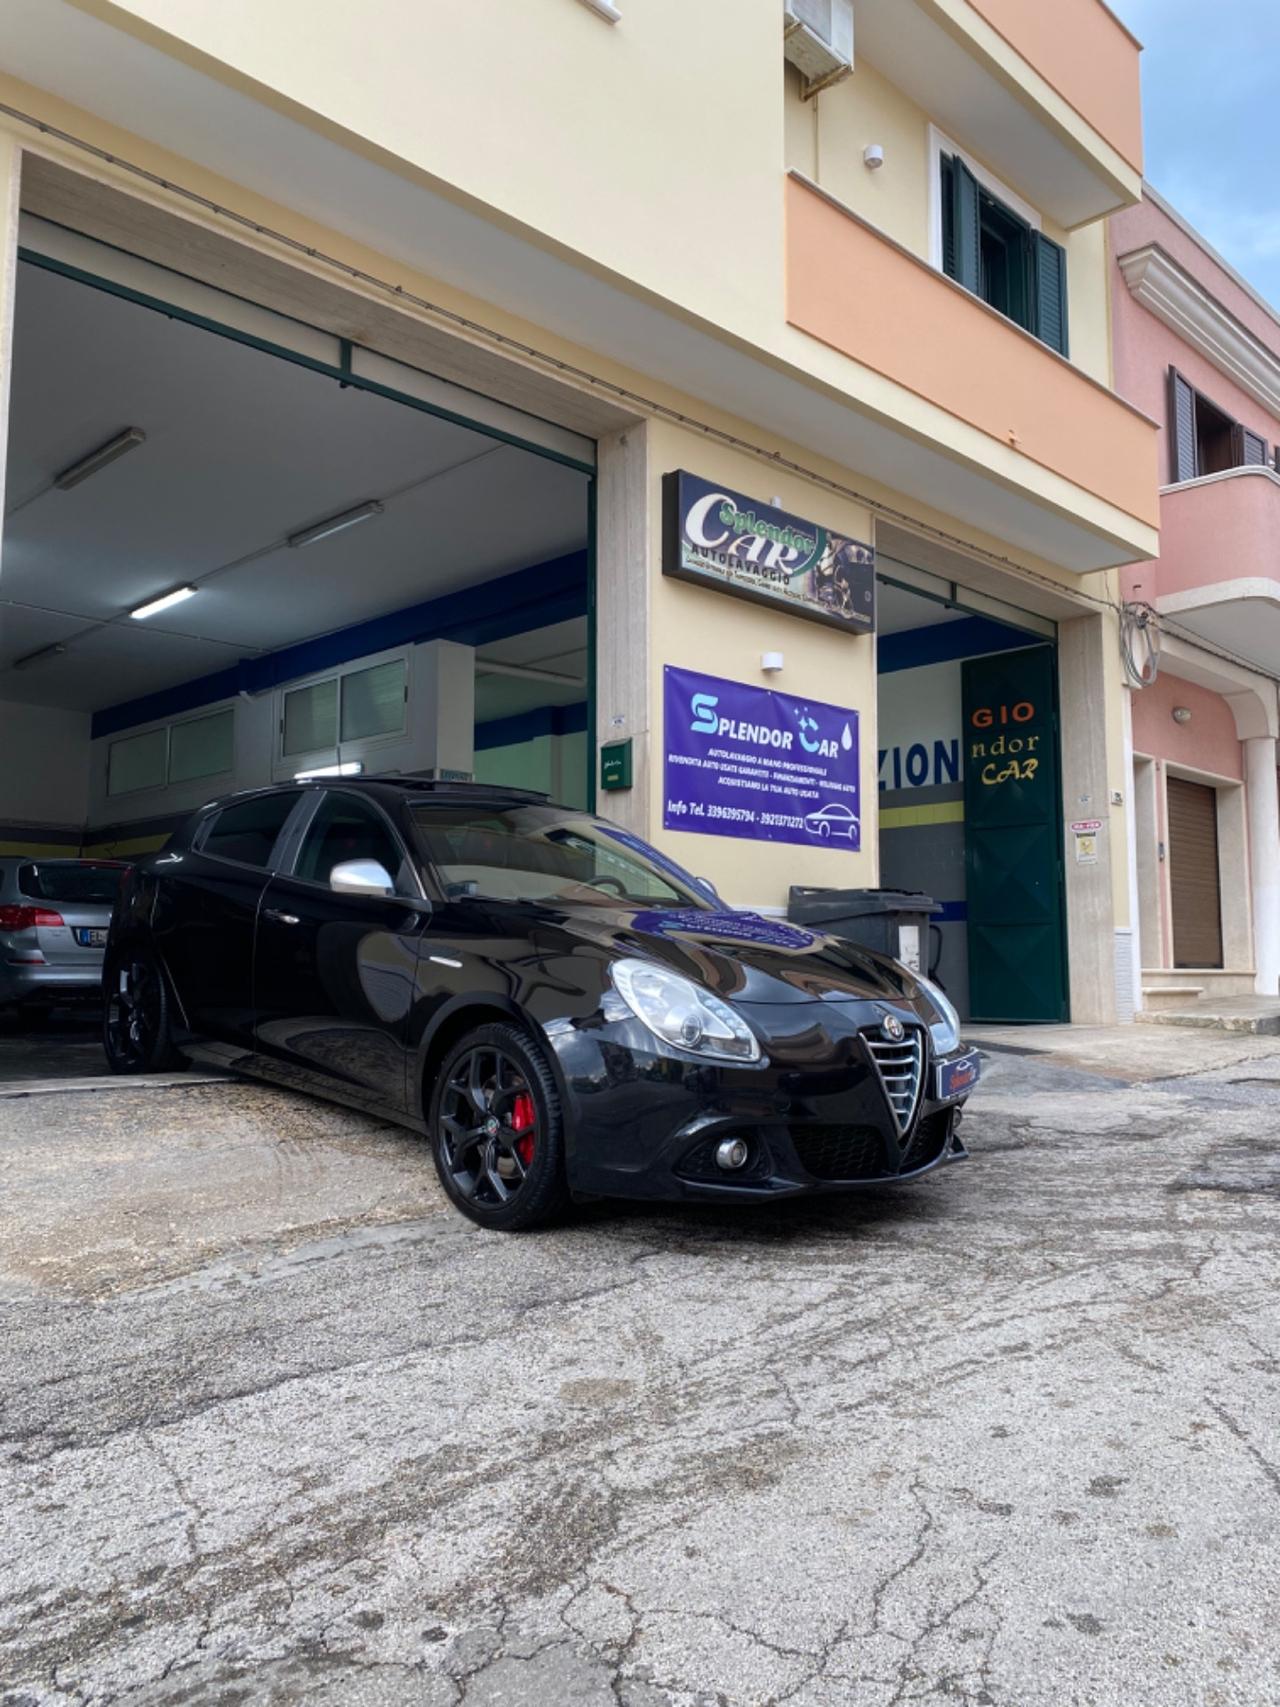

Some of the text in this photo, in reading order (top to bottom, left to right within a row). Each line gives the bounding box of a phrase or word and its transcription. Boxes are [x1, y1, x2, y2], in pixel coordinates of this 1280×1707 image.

[719, 502, 817, 555] Splendor
[691, 544, 790, 585] AUTOLAVAGGIO
[690, 692, 839, 759] SPLENDOR CAR
[971, 701, 1036, 728] GIO
[971, 733, 1041, 759] ndor
[668, 754, 701, 766] RIVENDITA
[703, 760, 719, 770] AUTO
[708, 748, 757, 764] AUTOLAVAGGIO
[763, 758, 781, 768] MANO
[783, 762, 827, 776] PROFESSIONALE
[980, 758, 1040, 786] CAR
[718, 776, 761, 790] ACQUISTIAMO
[762, 783, 769, 791] LA
[770, 784, 782, 793] TUA
[783, 786, 799, 796] AUTO
[668, 799, 687, 815] Info
